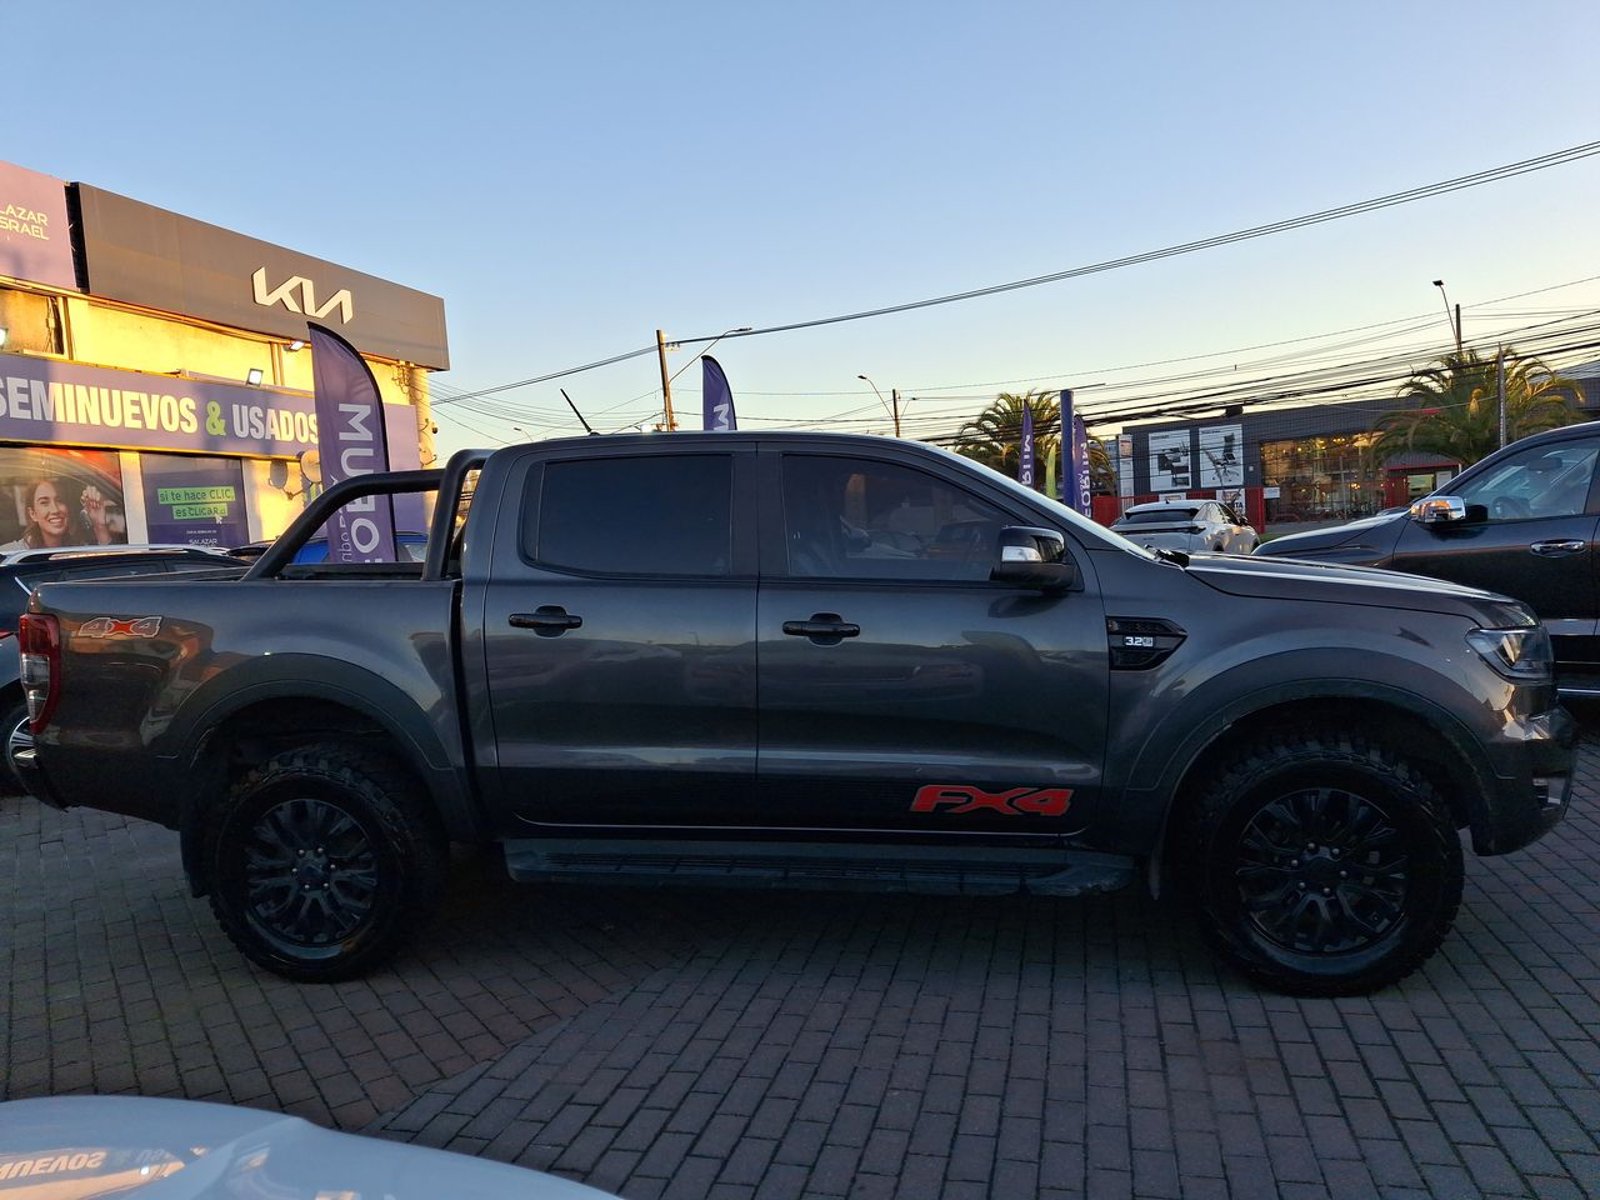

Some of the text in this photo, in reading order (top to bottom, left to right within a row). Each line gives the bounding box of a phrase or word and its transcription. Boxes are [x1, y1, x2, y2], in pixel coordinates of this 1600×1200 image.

[0, 203, 48, 226] AZAR
[251, 266, 353, 324] KIA
[206, 400, 226, 437] &
[232, 404, 319, 444] USADOS
[160, 491, 169, 502] si
[171, 491, 181, 501] te
[185, 491, 207, 501] hace
[910, 784, 1075, 816] FX4
